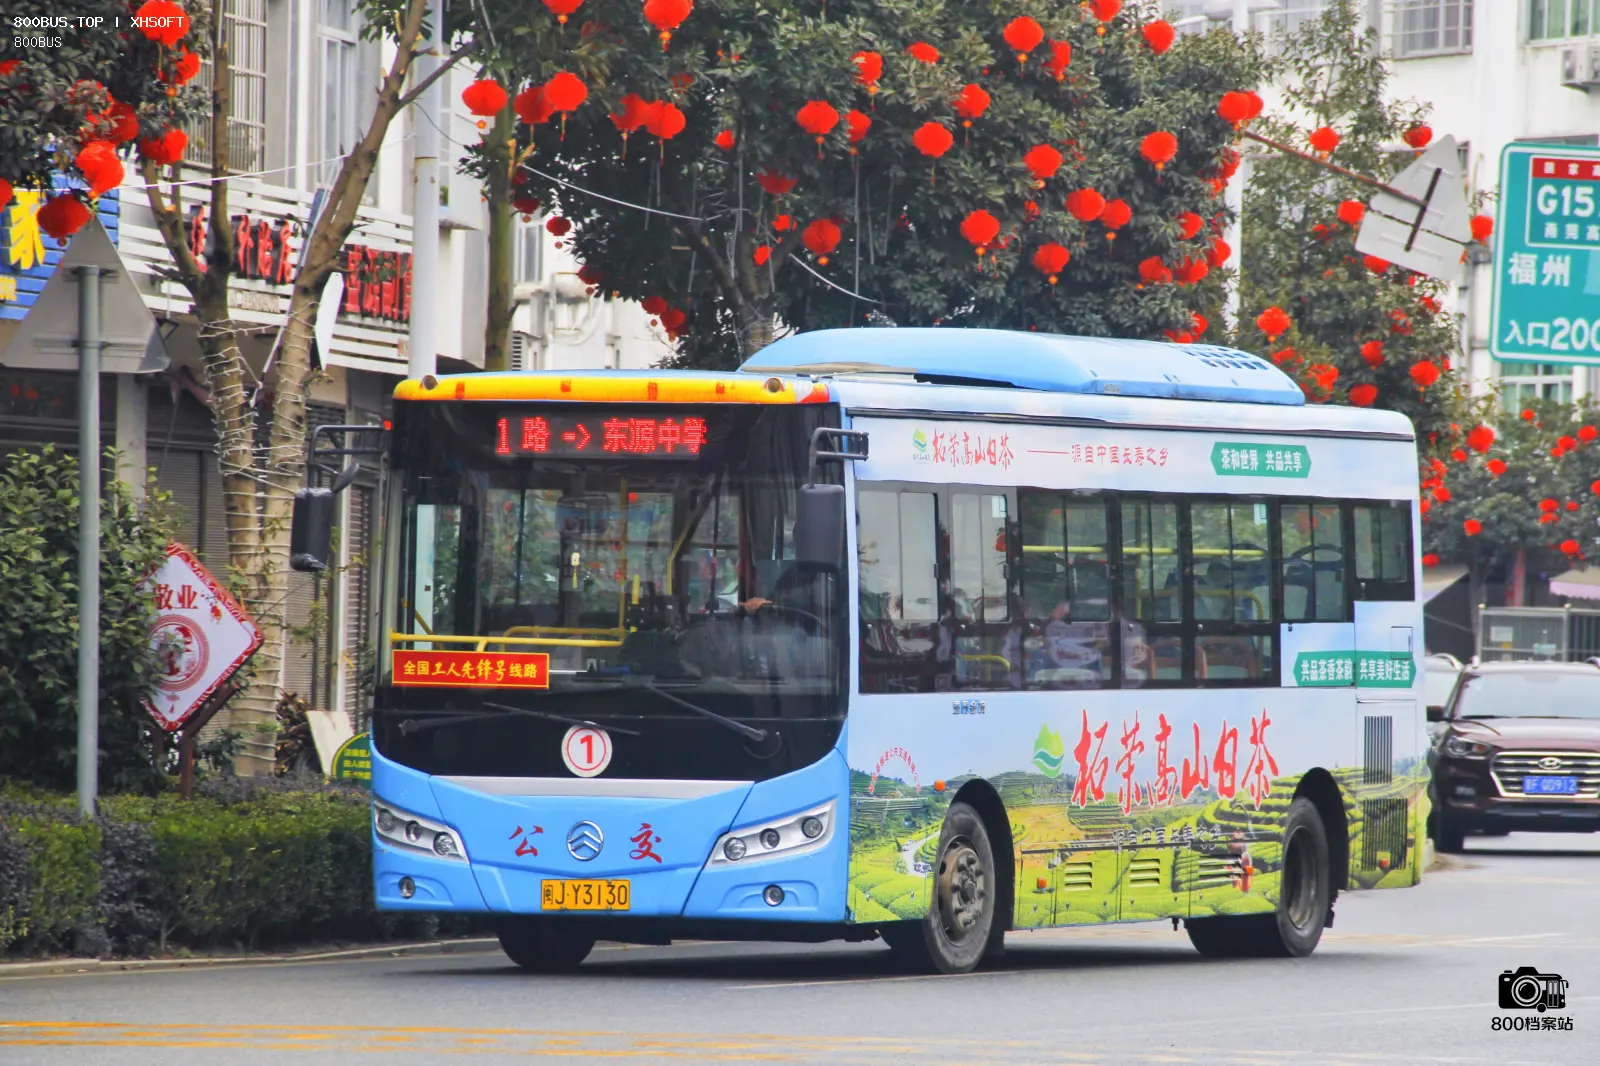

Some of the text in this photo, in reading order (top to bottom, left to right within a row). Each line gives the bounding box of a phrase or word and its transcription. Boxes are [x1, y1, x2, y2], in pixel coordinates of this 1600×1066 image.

[1537, 184, 1600, 217] G15
[1507, 252, 1570, 287] 福州
[522, 415, 550, 453] 路
[603, 416, 707, 454] 东源中学
[1220, 447, 1303, 473] 茶和世界 共品共享
[152, 583, 199, 610] 敬业
[403, 658, 538, 682] 全国工人先锋号线路
[1359, 657, 1411, 681] 共享美好生活
[580, 735, 593, 764] 1
[508, 822, 663, 864] 公 交
